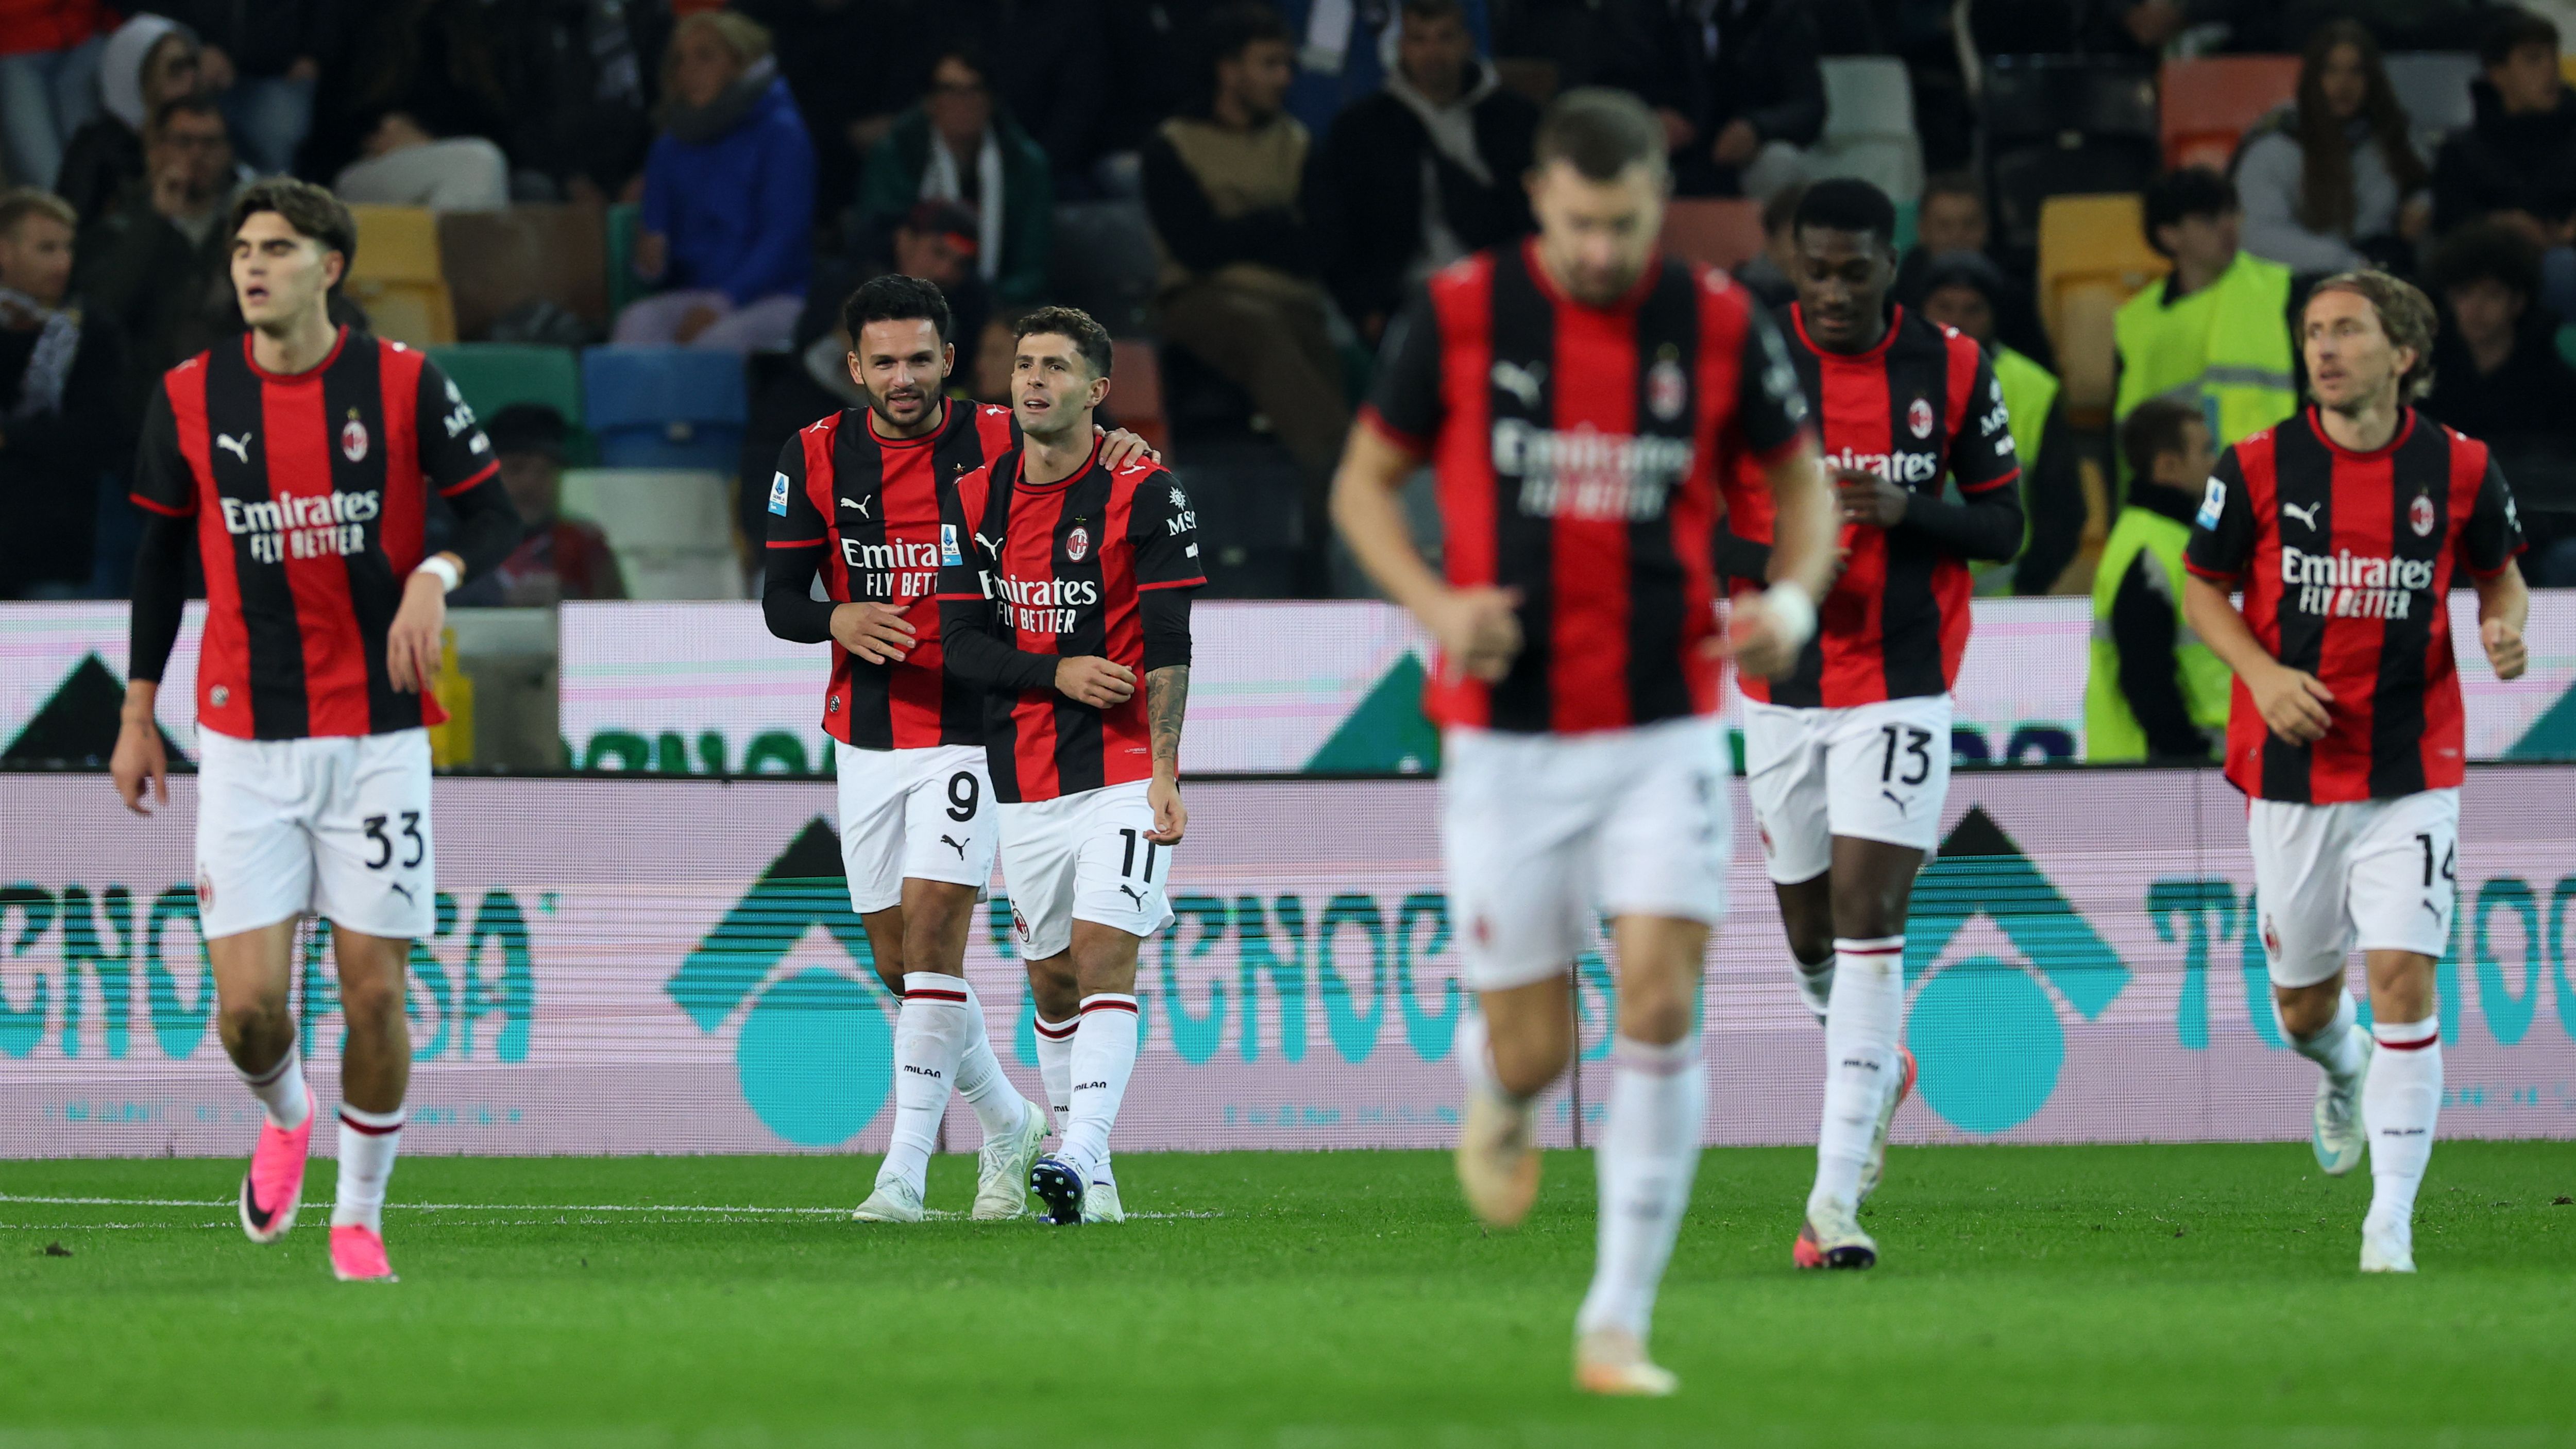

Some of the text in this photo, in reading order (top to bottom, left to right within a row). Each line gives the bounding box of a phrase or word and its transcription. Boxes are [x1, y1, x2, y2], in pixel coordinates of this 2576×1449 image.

[1813, 446, 1937, 483] mirates
[220, 489, 380, 534] Emirates
[250, 522, 365, 564] FLY BETTER
[841, 538, 940, 569] Emira
[867, 572, 939, 596] FLY BETT
[978, 570, 1097, 606] Emirates
[2282, 545, 2435, 590] Emirates
[996, 601, 1077, 634] FLY BETTER
[2299, 585, 2412, 620] FLY BETTER
[1882, 725, 1931, 786] 13
[946, 771, 979, 822] 9
[364, 812, 423, 870] 33
[1120, 828, 1156, 883] 11
[2416, 833, 2454, 887] 14
[1054, 1104, 1070, 1113] MIL
